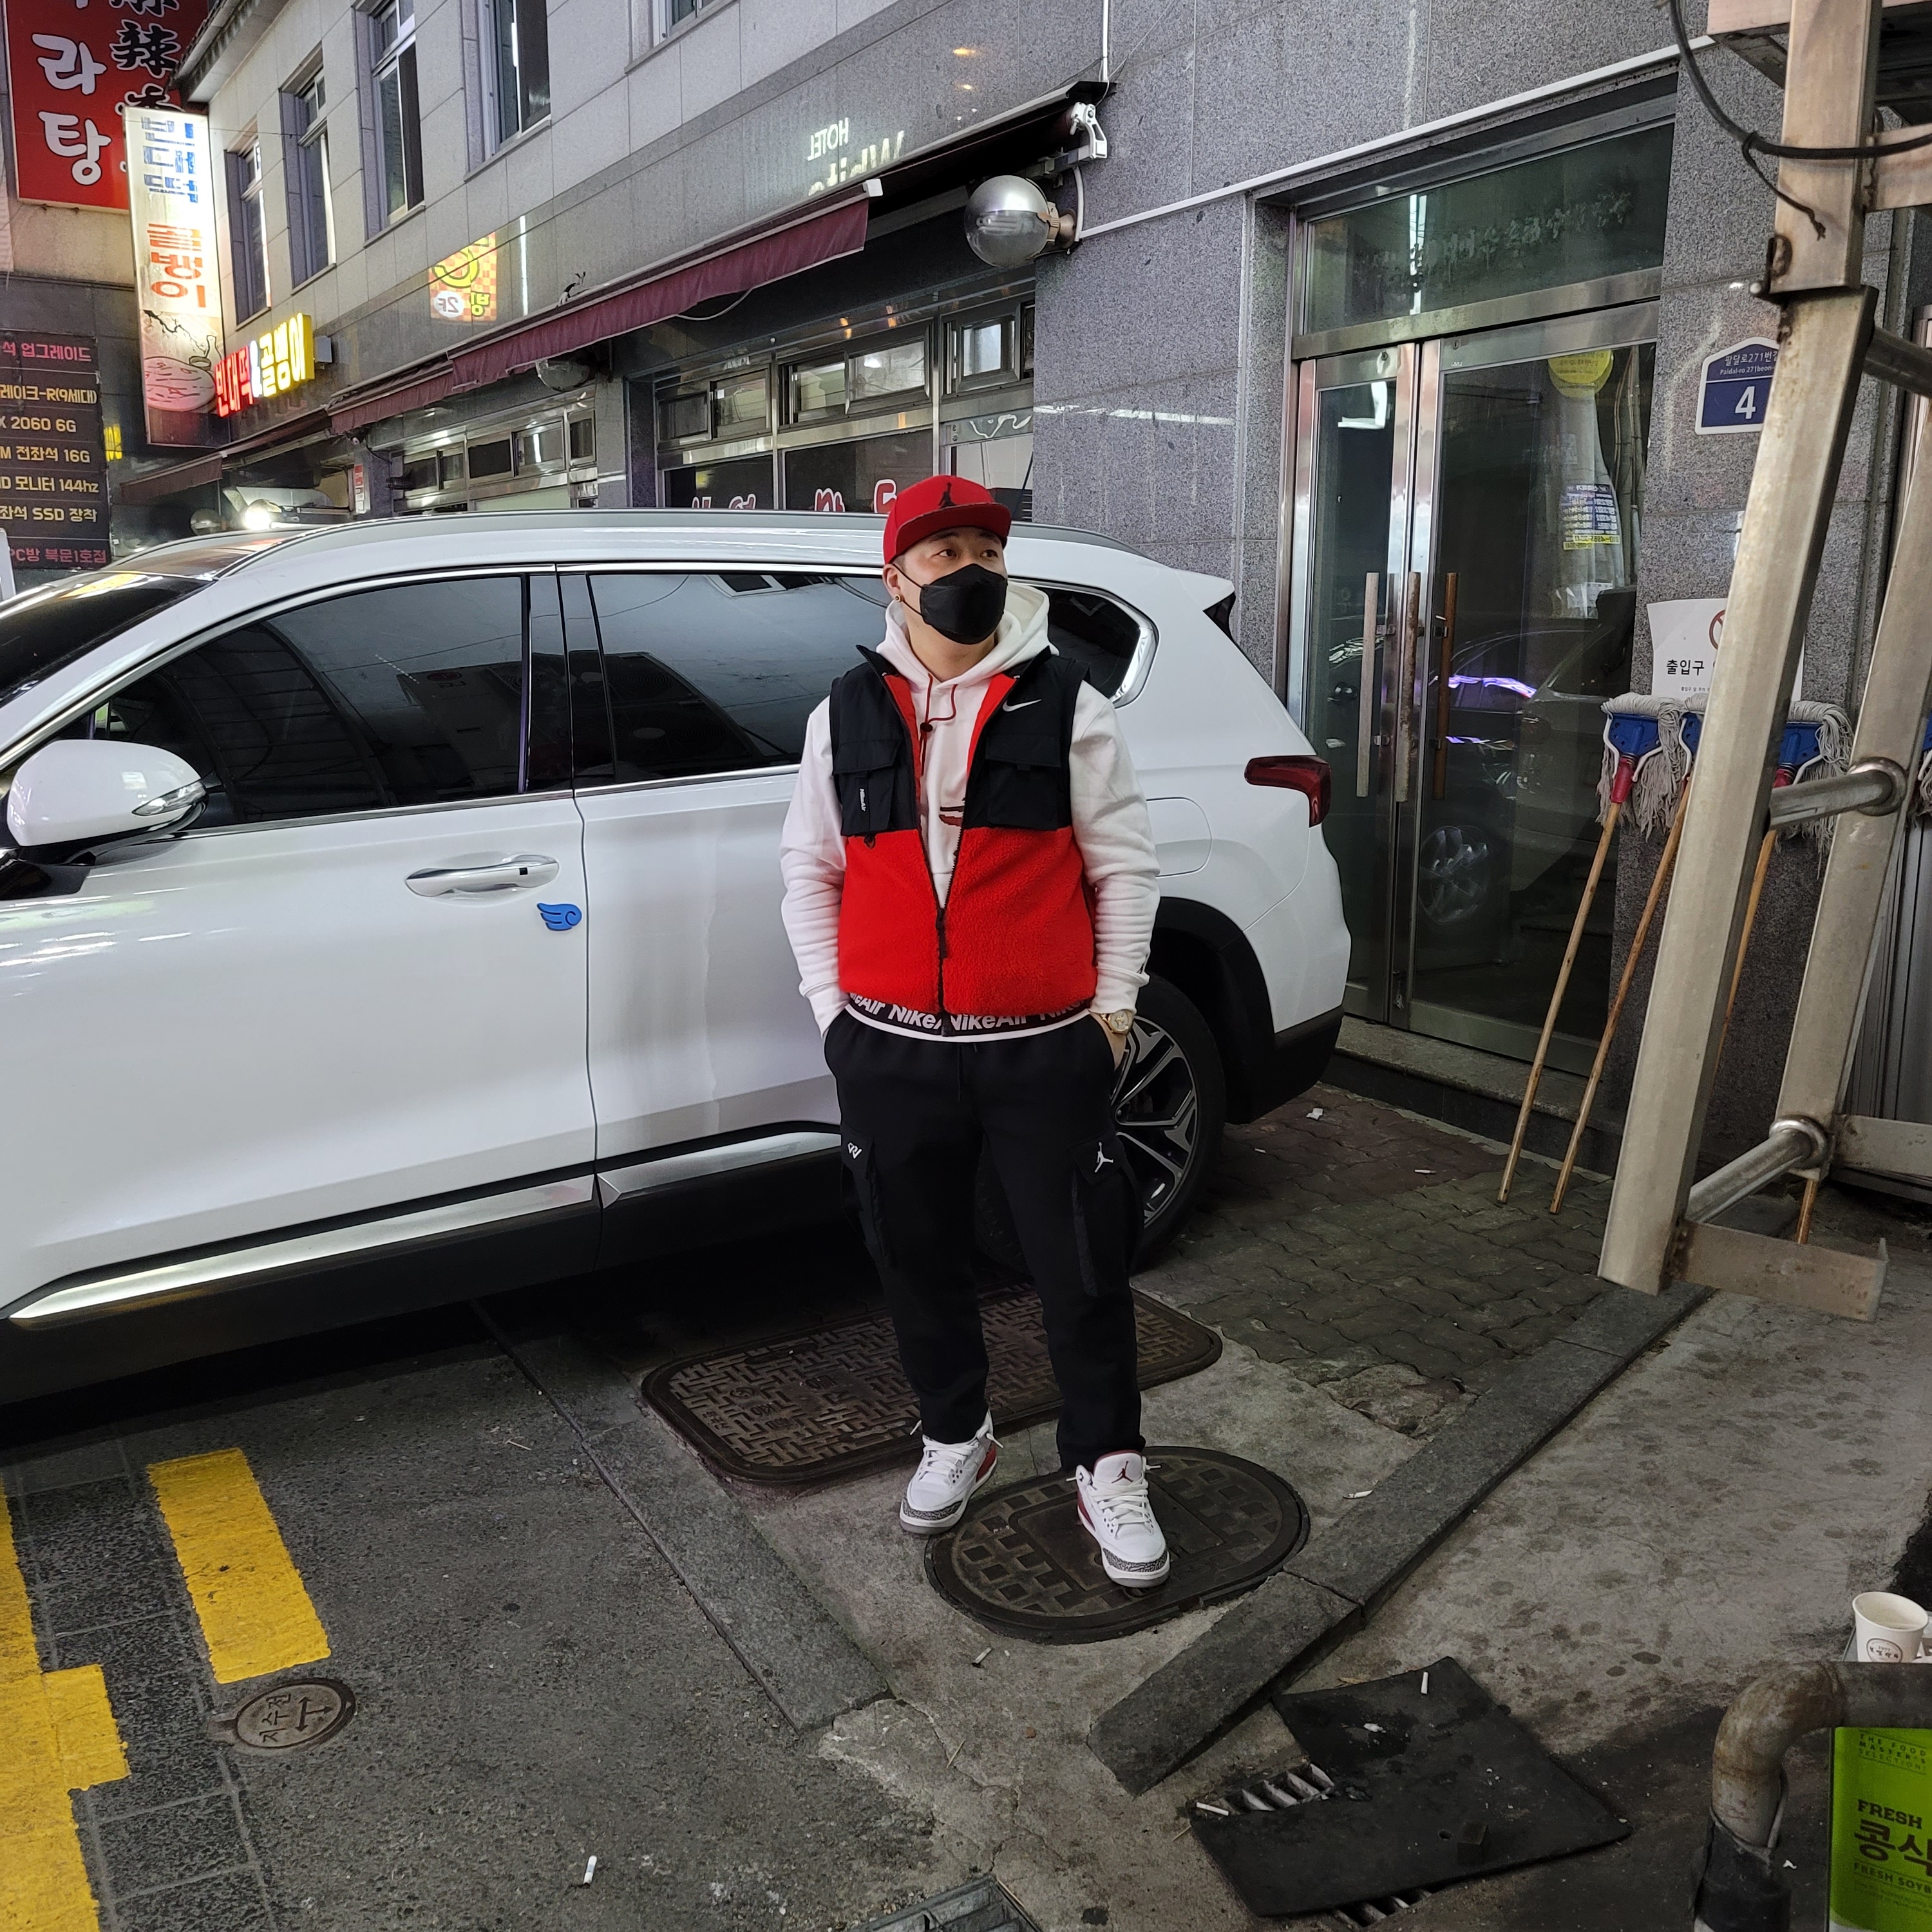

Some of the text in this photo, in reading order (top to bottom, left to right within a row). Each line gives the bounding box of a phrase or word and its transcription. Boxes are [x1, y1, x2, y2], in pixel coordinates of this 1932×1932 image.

[32, 0, 112, 185] 라탕
[21, 343, 92, 362] 업그레이드
[1735, 386, 1757, 419] 4
[10, 417, 52, 431] 2060
[55, 419, 77, 433] 6G
[15, 446, 59, 462] 전좌석
[63, 449, 90, 463] 16G
[15, 476, 55, 491] 모니터
[59, 478, 100, 493] 144hz
[32, 507, 64, 521] SSD
[69, 507, 98, 523] 장착
[45, 548, 107, 564] 북문1호점
[1666, 659, 1705, 676] 출입구
[1857, 1799, 1923, 1830] FRESH
[1854, 1861, 1893, 1883] FRESH
